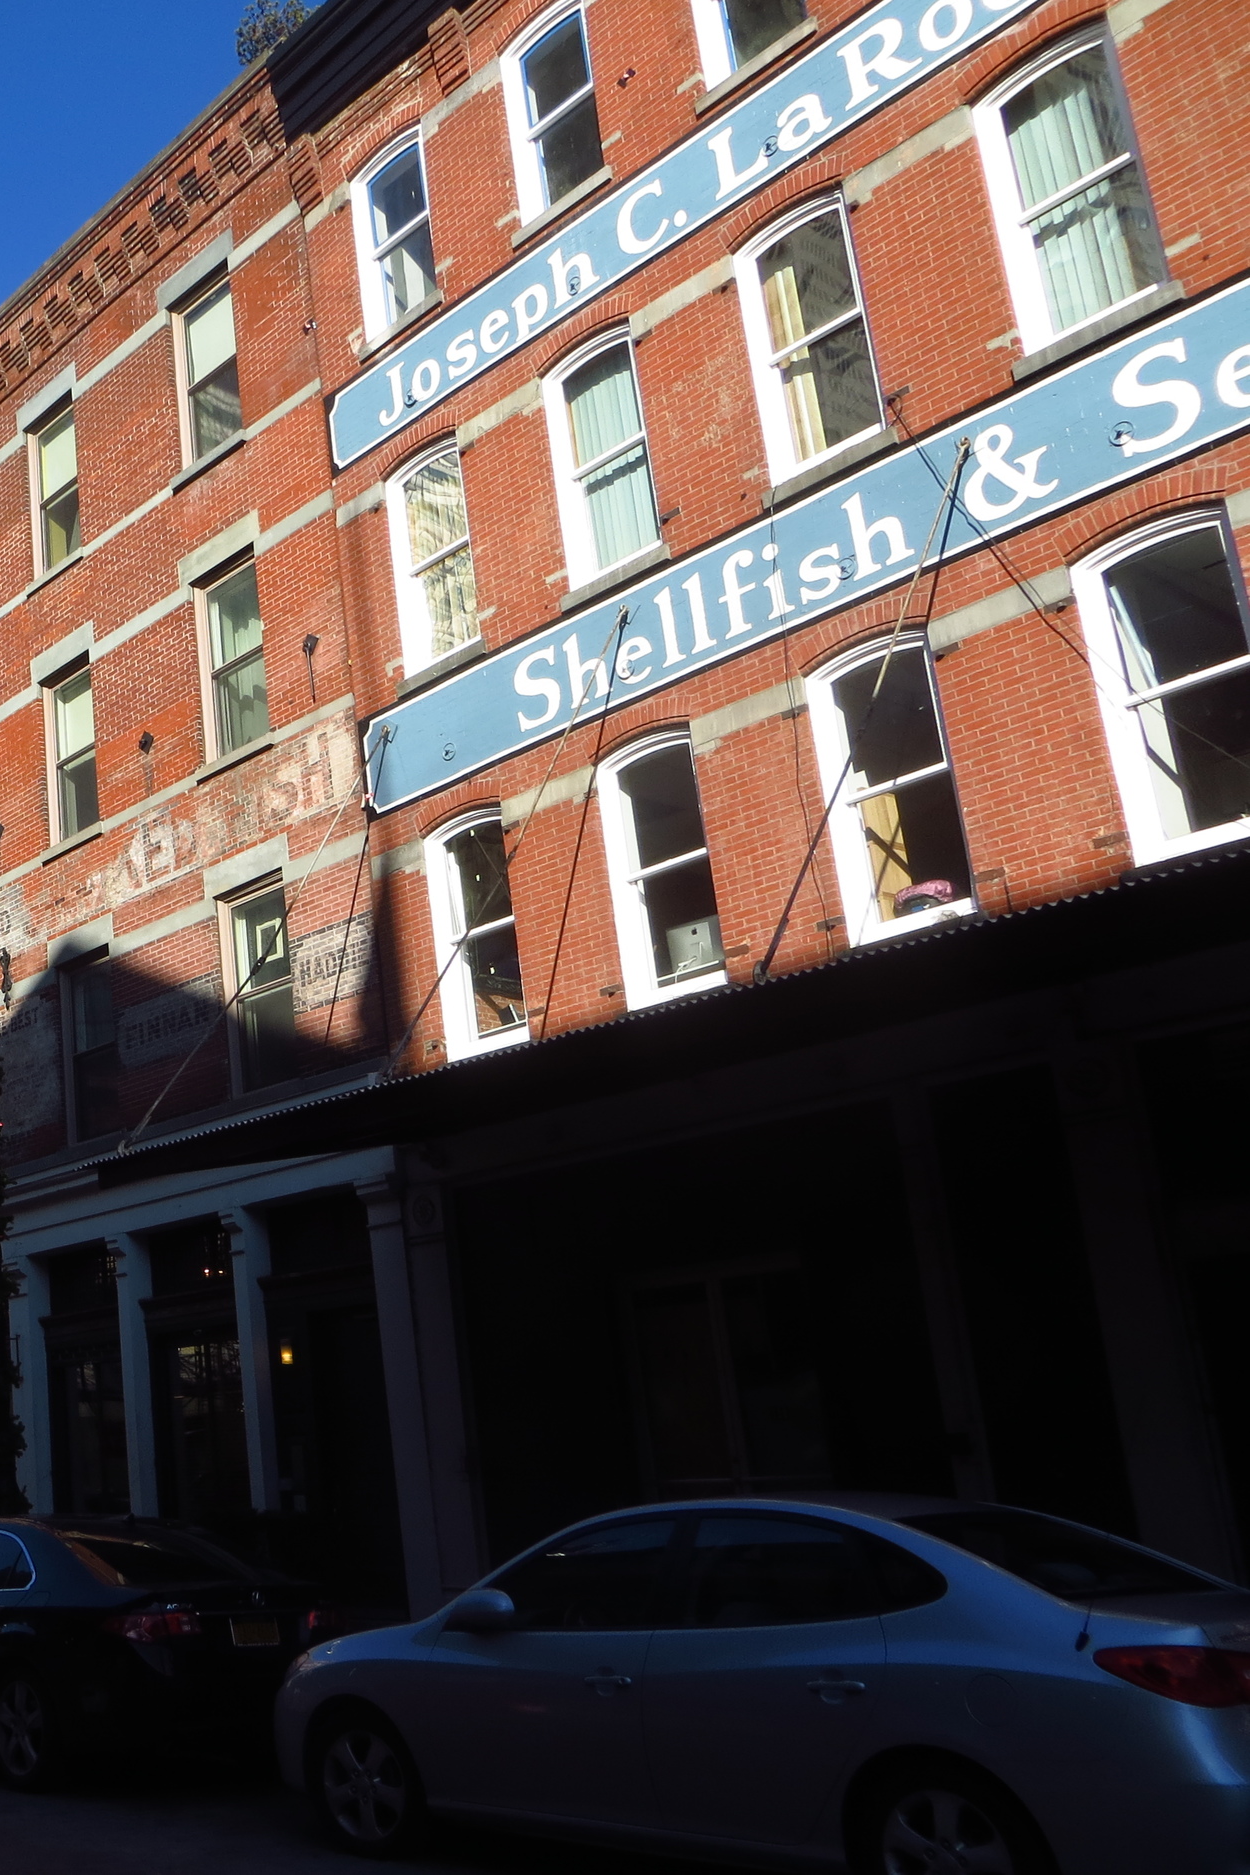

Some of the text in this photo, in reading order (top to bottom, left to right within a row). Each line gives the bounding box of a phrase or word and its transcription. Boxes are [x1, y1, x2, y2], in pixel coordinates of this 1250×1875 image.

[378, 248, 600, 428] Joseph
[616, 179, 688, 255] C.
[513, 492, 915, 732] Shellfish
[963, 423, 1060, 522] &
[10, 1006, 39, 1033] BEST
[124, 999, 210, 1050] FINNAN
